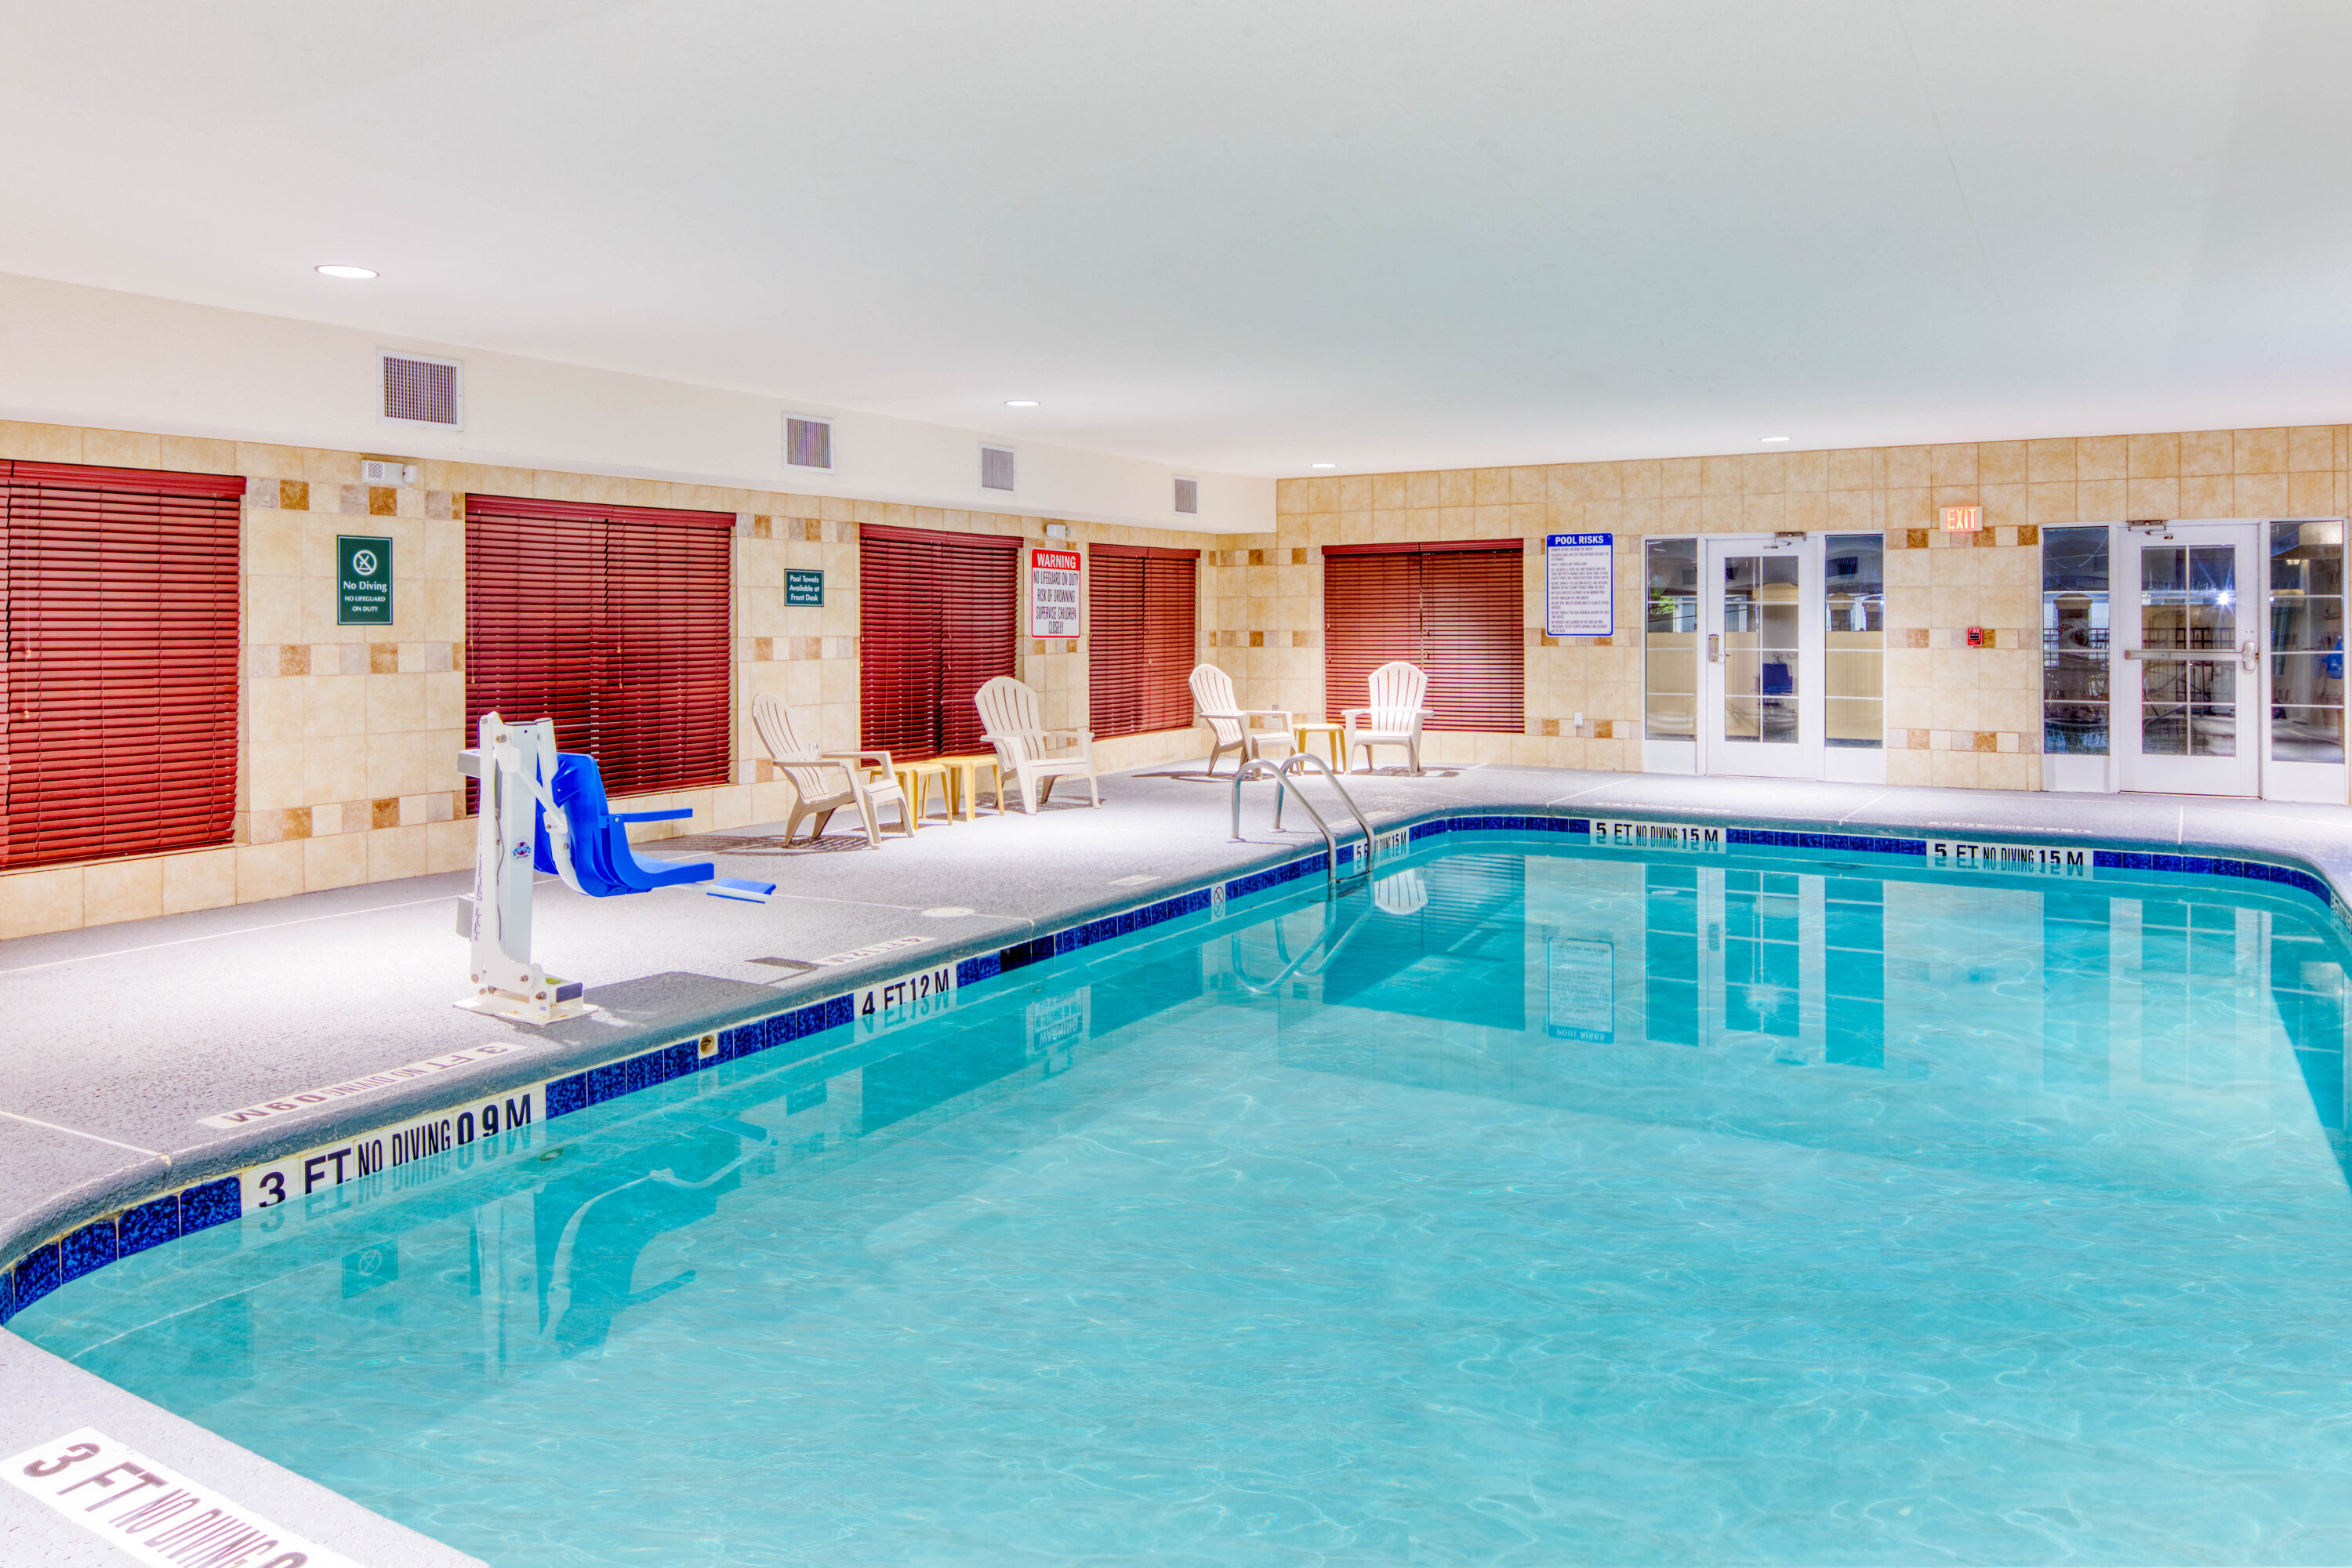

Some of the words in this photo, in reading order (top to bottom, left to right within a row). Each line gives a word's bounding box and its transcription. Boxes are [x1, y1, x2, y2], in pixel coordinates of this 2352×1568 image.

[1947, 508, 1976, 530] EXIT
[1555, 536, 1577, 545] POOL
[1578, 535, 1604, 544] RISKS
[1036, 553, 1076, 569] WARNING
[359, 581, 387, 593] Diving
[1033, 571, 1040, 584] NO
[1040, 571, 1061, 585] LIFEGUARD
[1062, 572, 1068, 586] ON
[1069, 572, 1079, 586] DUTY
[1036, 588, 1047, 602] RISK
[1047, 589, 1053, 602] OF
[1054, 589, 1076, 603] DROWNING
[1036, 605, 1057, 619] SUPERVISE
[1058, 606, 1076, 620] CHILDREN
[1048, 620, 1064, 634] CLOSELY
[1596, 822, 1606, 834] 5
[1636, 825, 1646, 838] NO
[1650, 826, 1678, 840] DIVING
[1934, 843, 1947, 857] 5
[1983, 846, 1996, 860] NO
[2001, 848, 2034, 863] DIVING
[862, 990, 876, 1016] 4
[476, 1046, 509, 1055] 3
[426, 1054, 476, 1071] FT
[390, 1067, 430, 1079] NO
[319, 1076, 397, 1097] DIVING
[259, 1171, 286, 1208] 3
[358, 1139, 383, 1178] NO
[392, 1119, 451, 1167] DIVING
[23, 1443, 101, 1478] 3
[56, 1461, 169, 1512] FT
[107, 1487, 201, 1534] NO
[143, 1507, 279, 1568] DIVING
